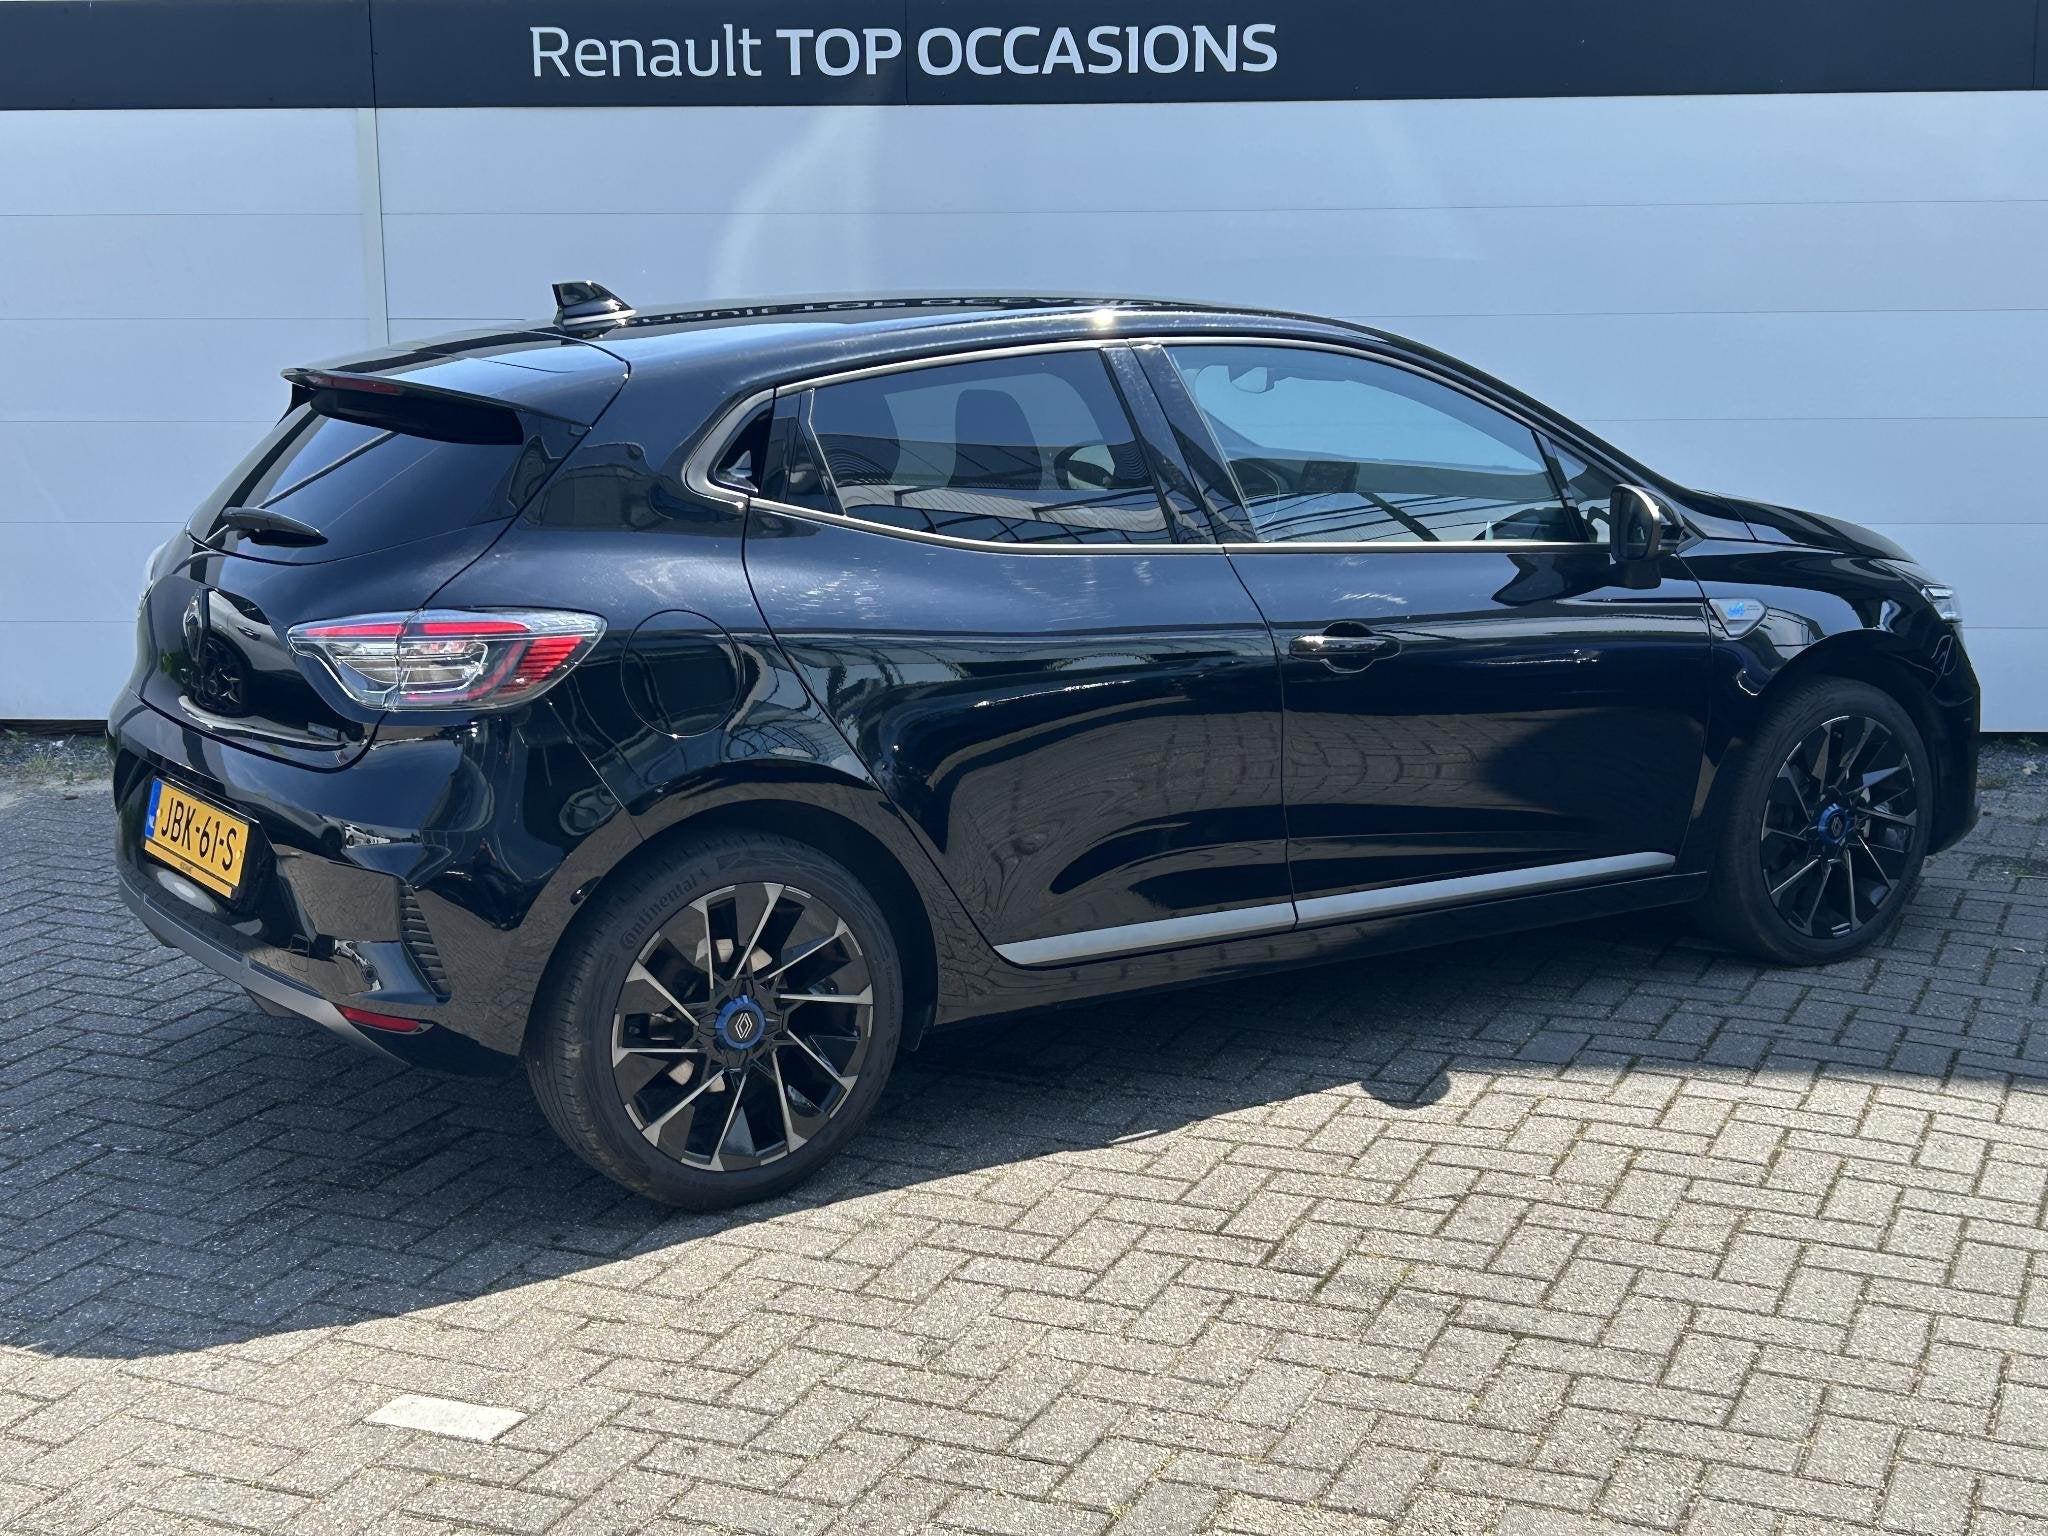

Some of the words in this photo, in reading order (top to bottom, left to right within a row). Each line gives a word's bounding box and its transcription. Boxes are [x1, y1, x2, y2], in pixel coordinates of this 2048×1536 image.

[530, 24, 761, 78] Renault
[776, 28, 901, 77] TOP
[917, 24, 1277, 76] OCCASIONS
[161, 797, 237, 871] JBK-61-S
